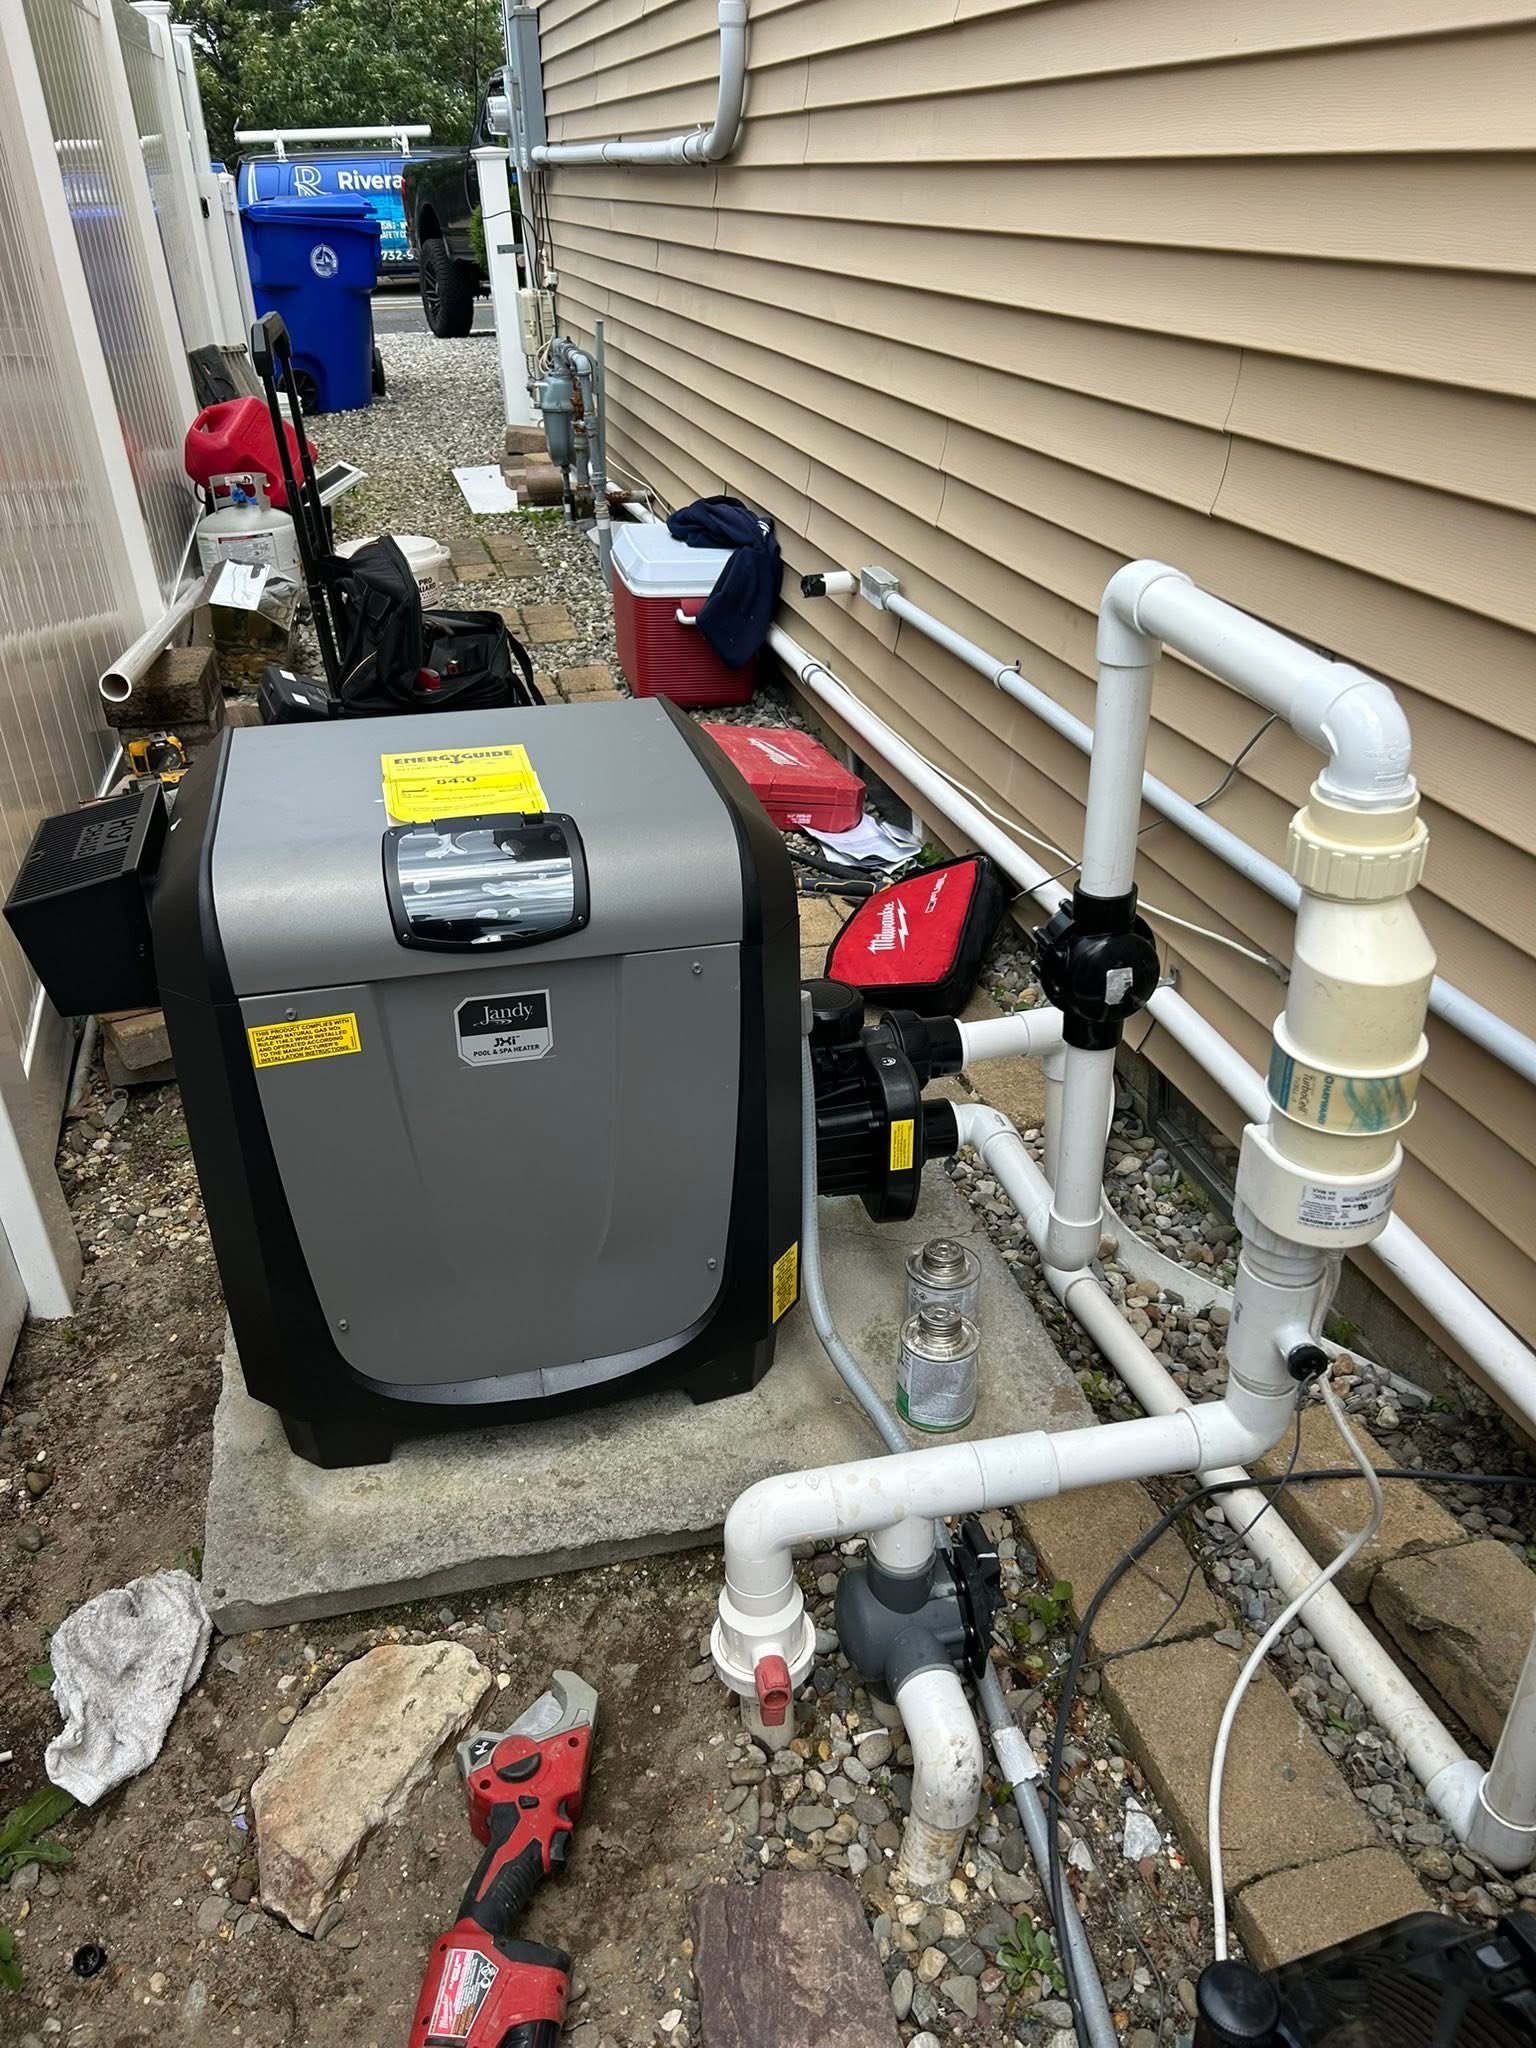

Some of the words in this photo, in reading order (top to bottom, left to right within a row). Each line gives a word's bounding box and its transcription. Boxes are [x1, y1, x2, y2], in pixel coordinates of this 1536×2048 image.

[338, 170, 404, 190] Rivera
[381, 250, 414, 260] 732-5
[419, 577, 432, 585] PRO
[419, 582, 436, 592] UARD
[394, 750, 513, 765] ENERGYGUIDE
[104, 815, 137, 846] HOT
[867, 901, 897, 955] Milwaukee
[480, 1002, 533, 1025] Jandy
[270, 1027, 298, 1035] PRODUCT
[301, 1021, 332, 1030] COMPLIES
[285, 1028, 312, 1037] NATURAL
[295, 1033, 313, 1041] WHEN
[314, 1029, 347, 1038] INSTALLED
[273, 1040, 306, 1050] OPERATED
[307, 1035, 344, 1045] ACCORDING
[514, 1044, 540, 1052] HEATER
[1317, 1083, 1331, 1124] HAYWARD
